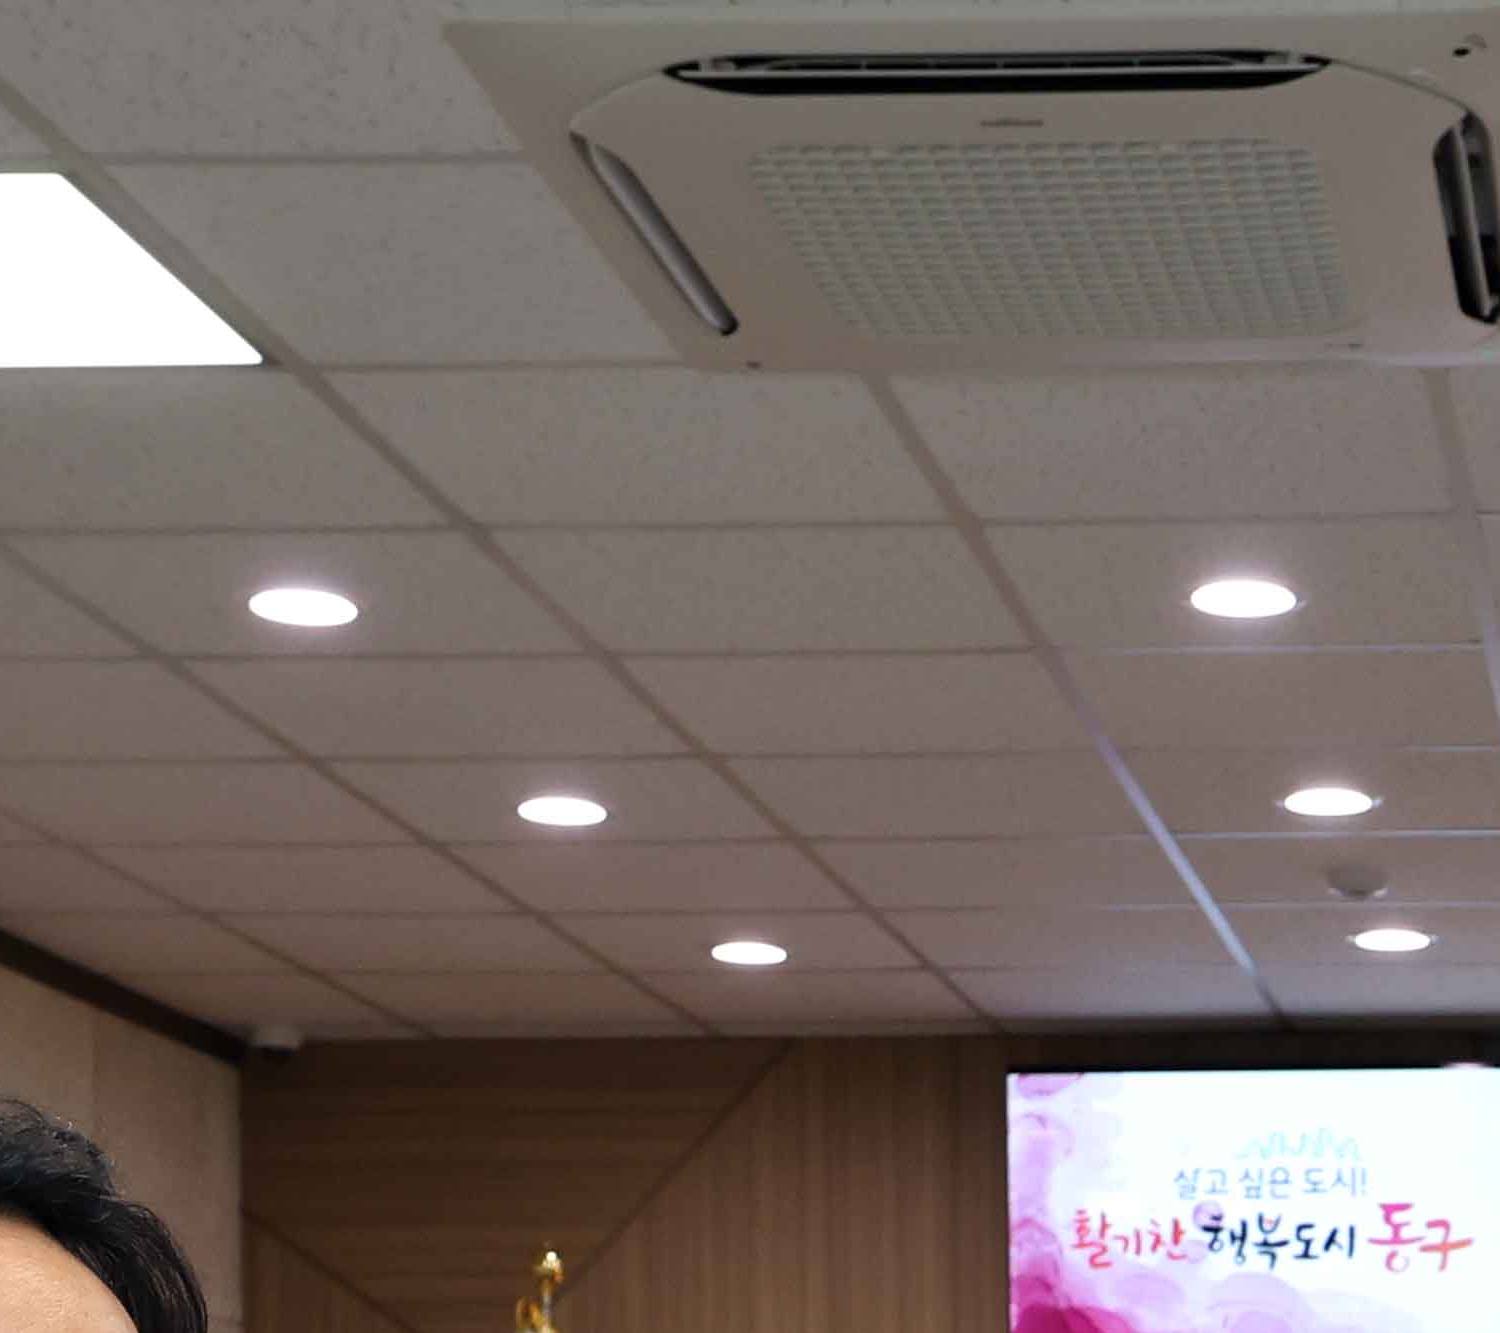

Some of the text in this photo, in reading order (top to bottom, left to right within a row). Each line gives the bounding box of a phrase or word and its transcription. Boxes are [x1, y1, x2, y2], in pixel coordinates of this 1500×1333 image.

[1173, 1166, 1368, 1200] 살고 싶은 도시!
[1070, 1202, 1474, 1273] 활기찬 행복도시 동구
